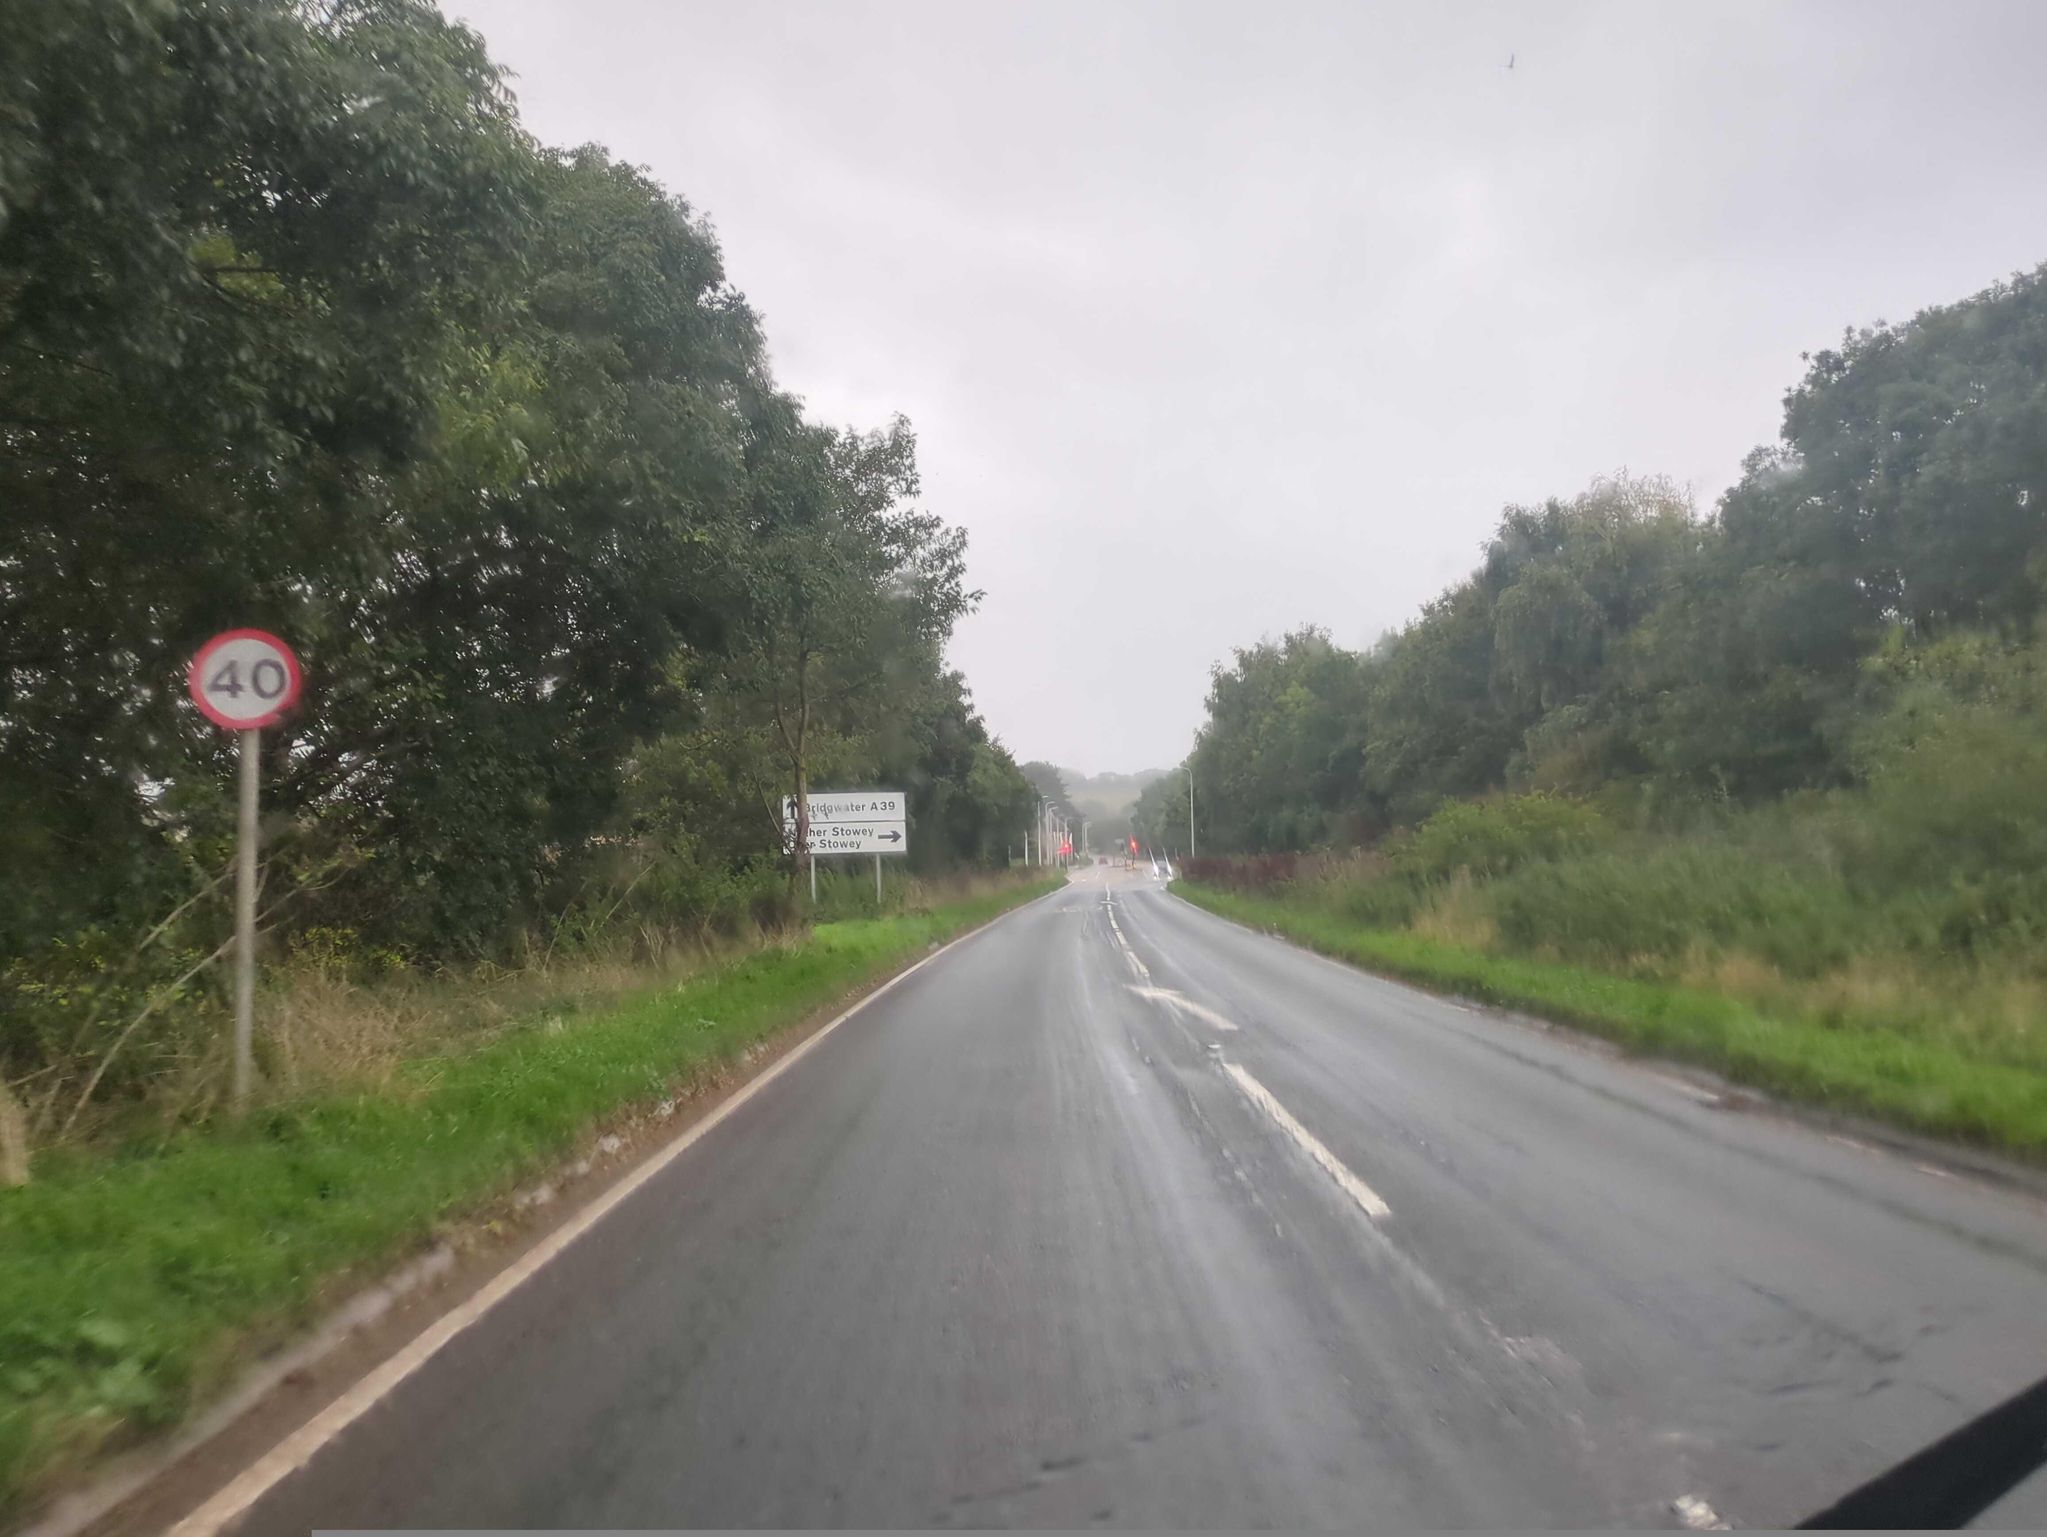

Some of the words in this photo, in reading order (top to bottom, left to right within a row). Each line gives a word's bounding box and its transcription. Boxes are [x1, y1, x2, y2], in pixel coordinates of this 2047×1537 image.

[209, 658, 286, 700] 40
[870, 801, 896, 811] A39
[831, 826, 874, 837] Stowey
[819, 839, 861, 849] Stowey
